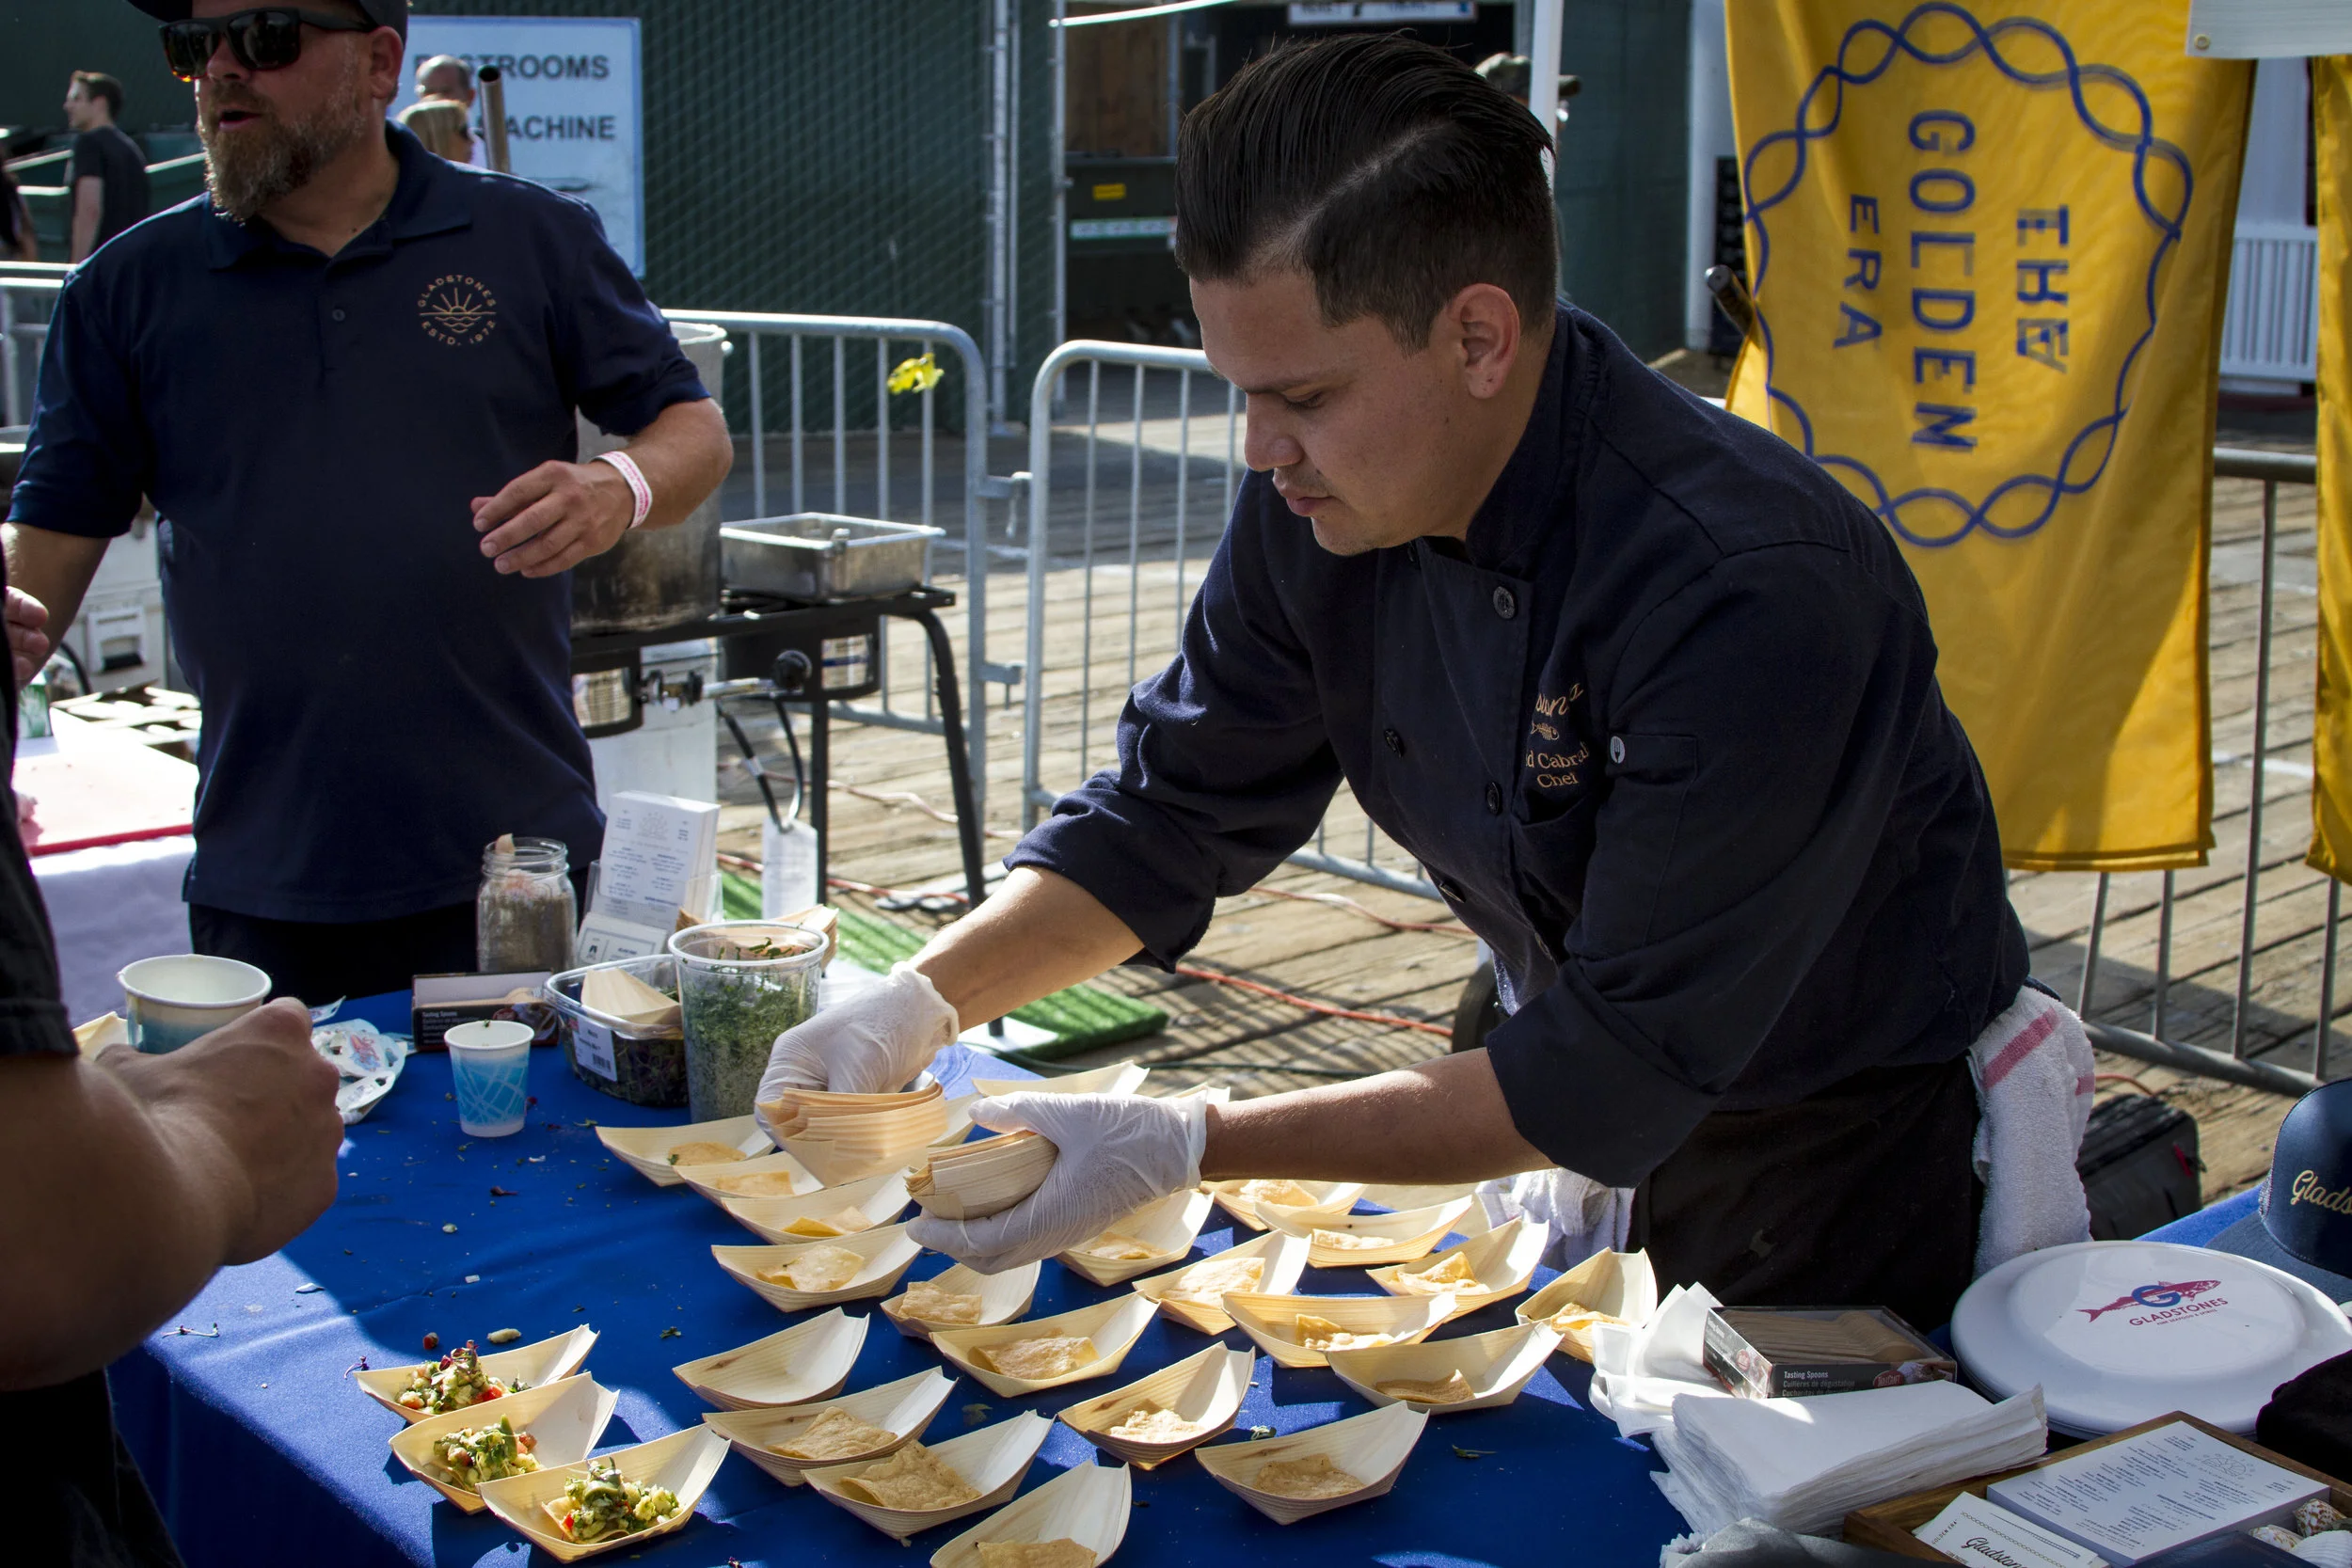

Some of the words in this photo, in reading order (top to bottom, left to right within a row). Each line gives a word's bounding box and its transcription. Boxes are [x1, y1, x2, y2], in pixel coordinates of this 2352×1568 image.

[413, 54, 610, 79] STROOMS
[477, 114, 616, 141] ACHINE
[1833, 194, 1882, 351] ERA
[1908, 109, 1978, 453] GOLDEN
[1537, 740, 1590, 769] Cabral
[2131, 1285, 2181, 1308] G
[2129, 1297, 2229, 1326] GLADSTONES
[1784, 1370, 1805, 1380] Tasting
[1806, 1370, 1829, 1379] Spoons
[1961, 1536, 2028, 1568] Gladston
